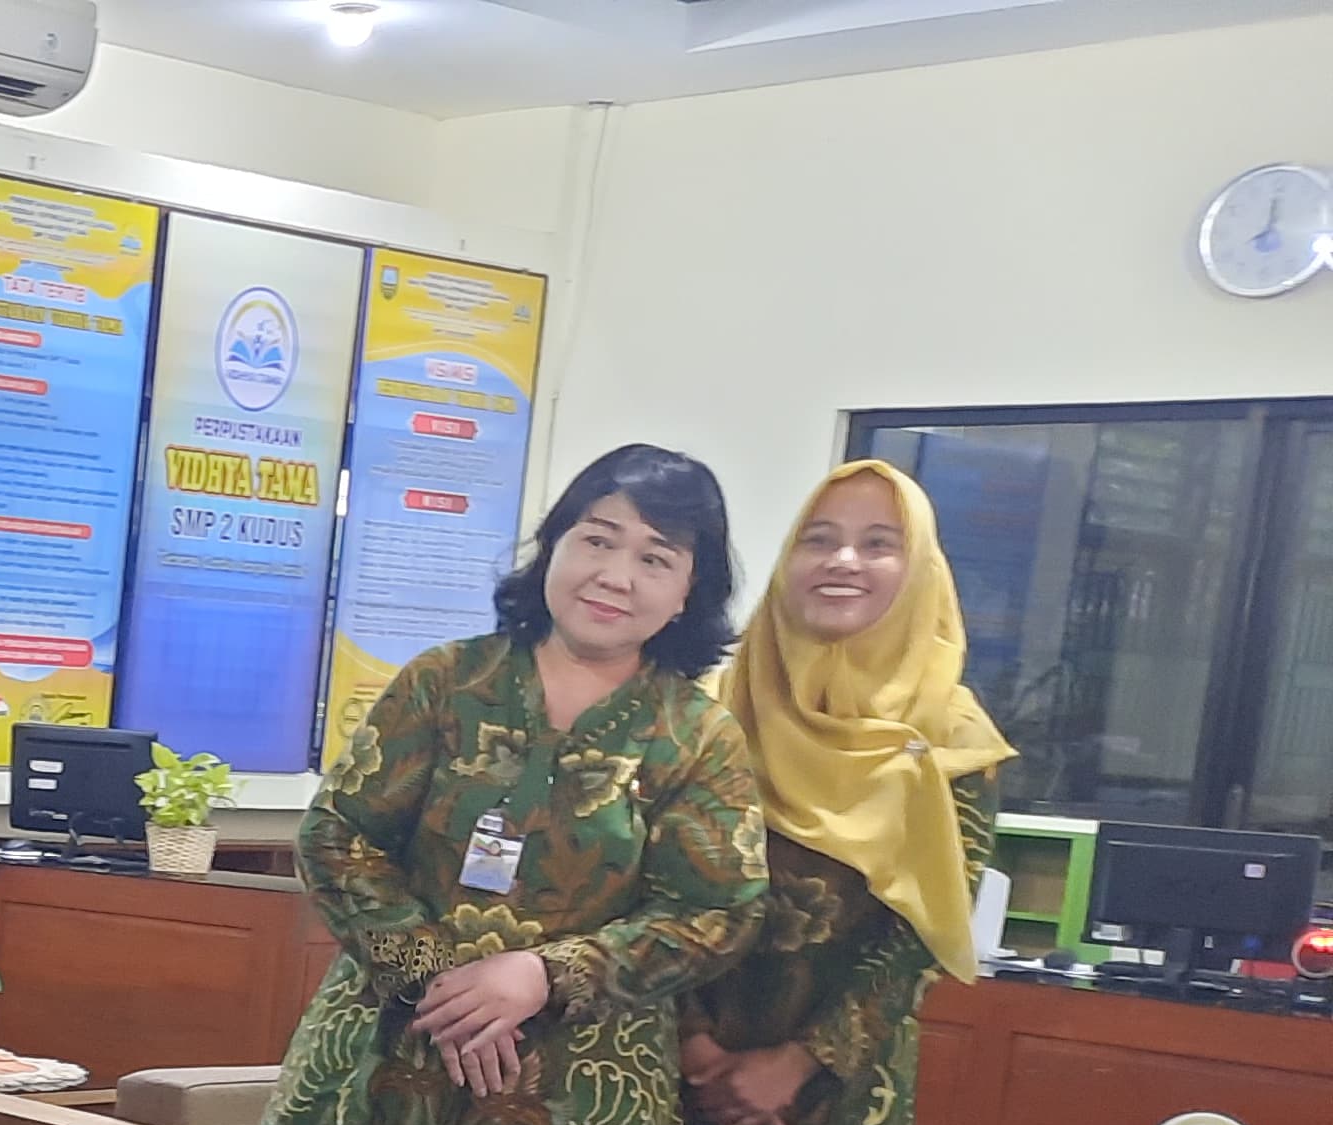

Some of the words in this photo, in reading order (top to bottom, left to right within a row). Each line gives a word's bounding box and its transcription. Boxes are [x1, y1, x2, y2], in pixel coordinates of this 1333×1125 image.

[194, 416, 303, 448] PERPUSTAKAAN
[165, 444, 253, 499] VIDHYA
[256, 456, 320, 506] TAMA
[171, 507, 216, 538] SMP
[219, 513, 233, 540] 2
[237, 514, 304, 548] KUDUS
